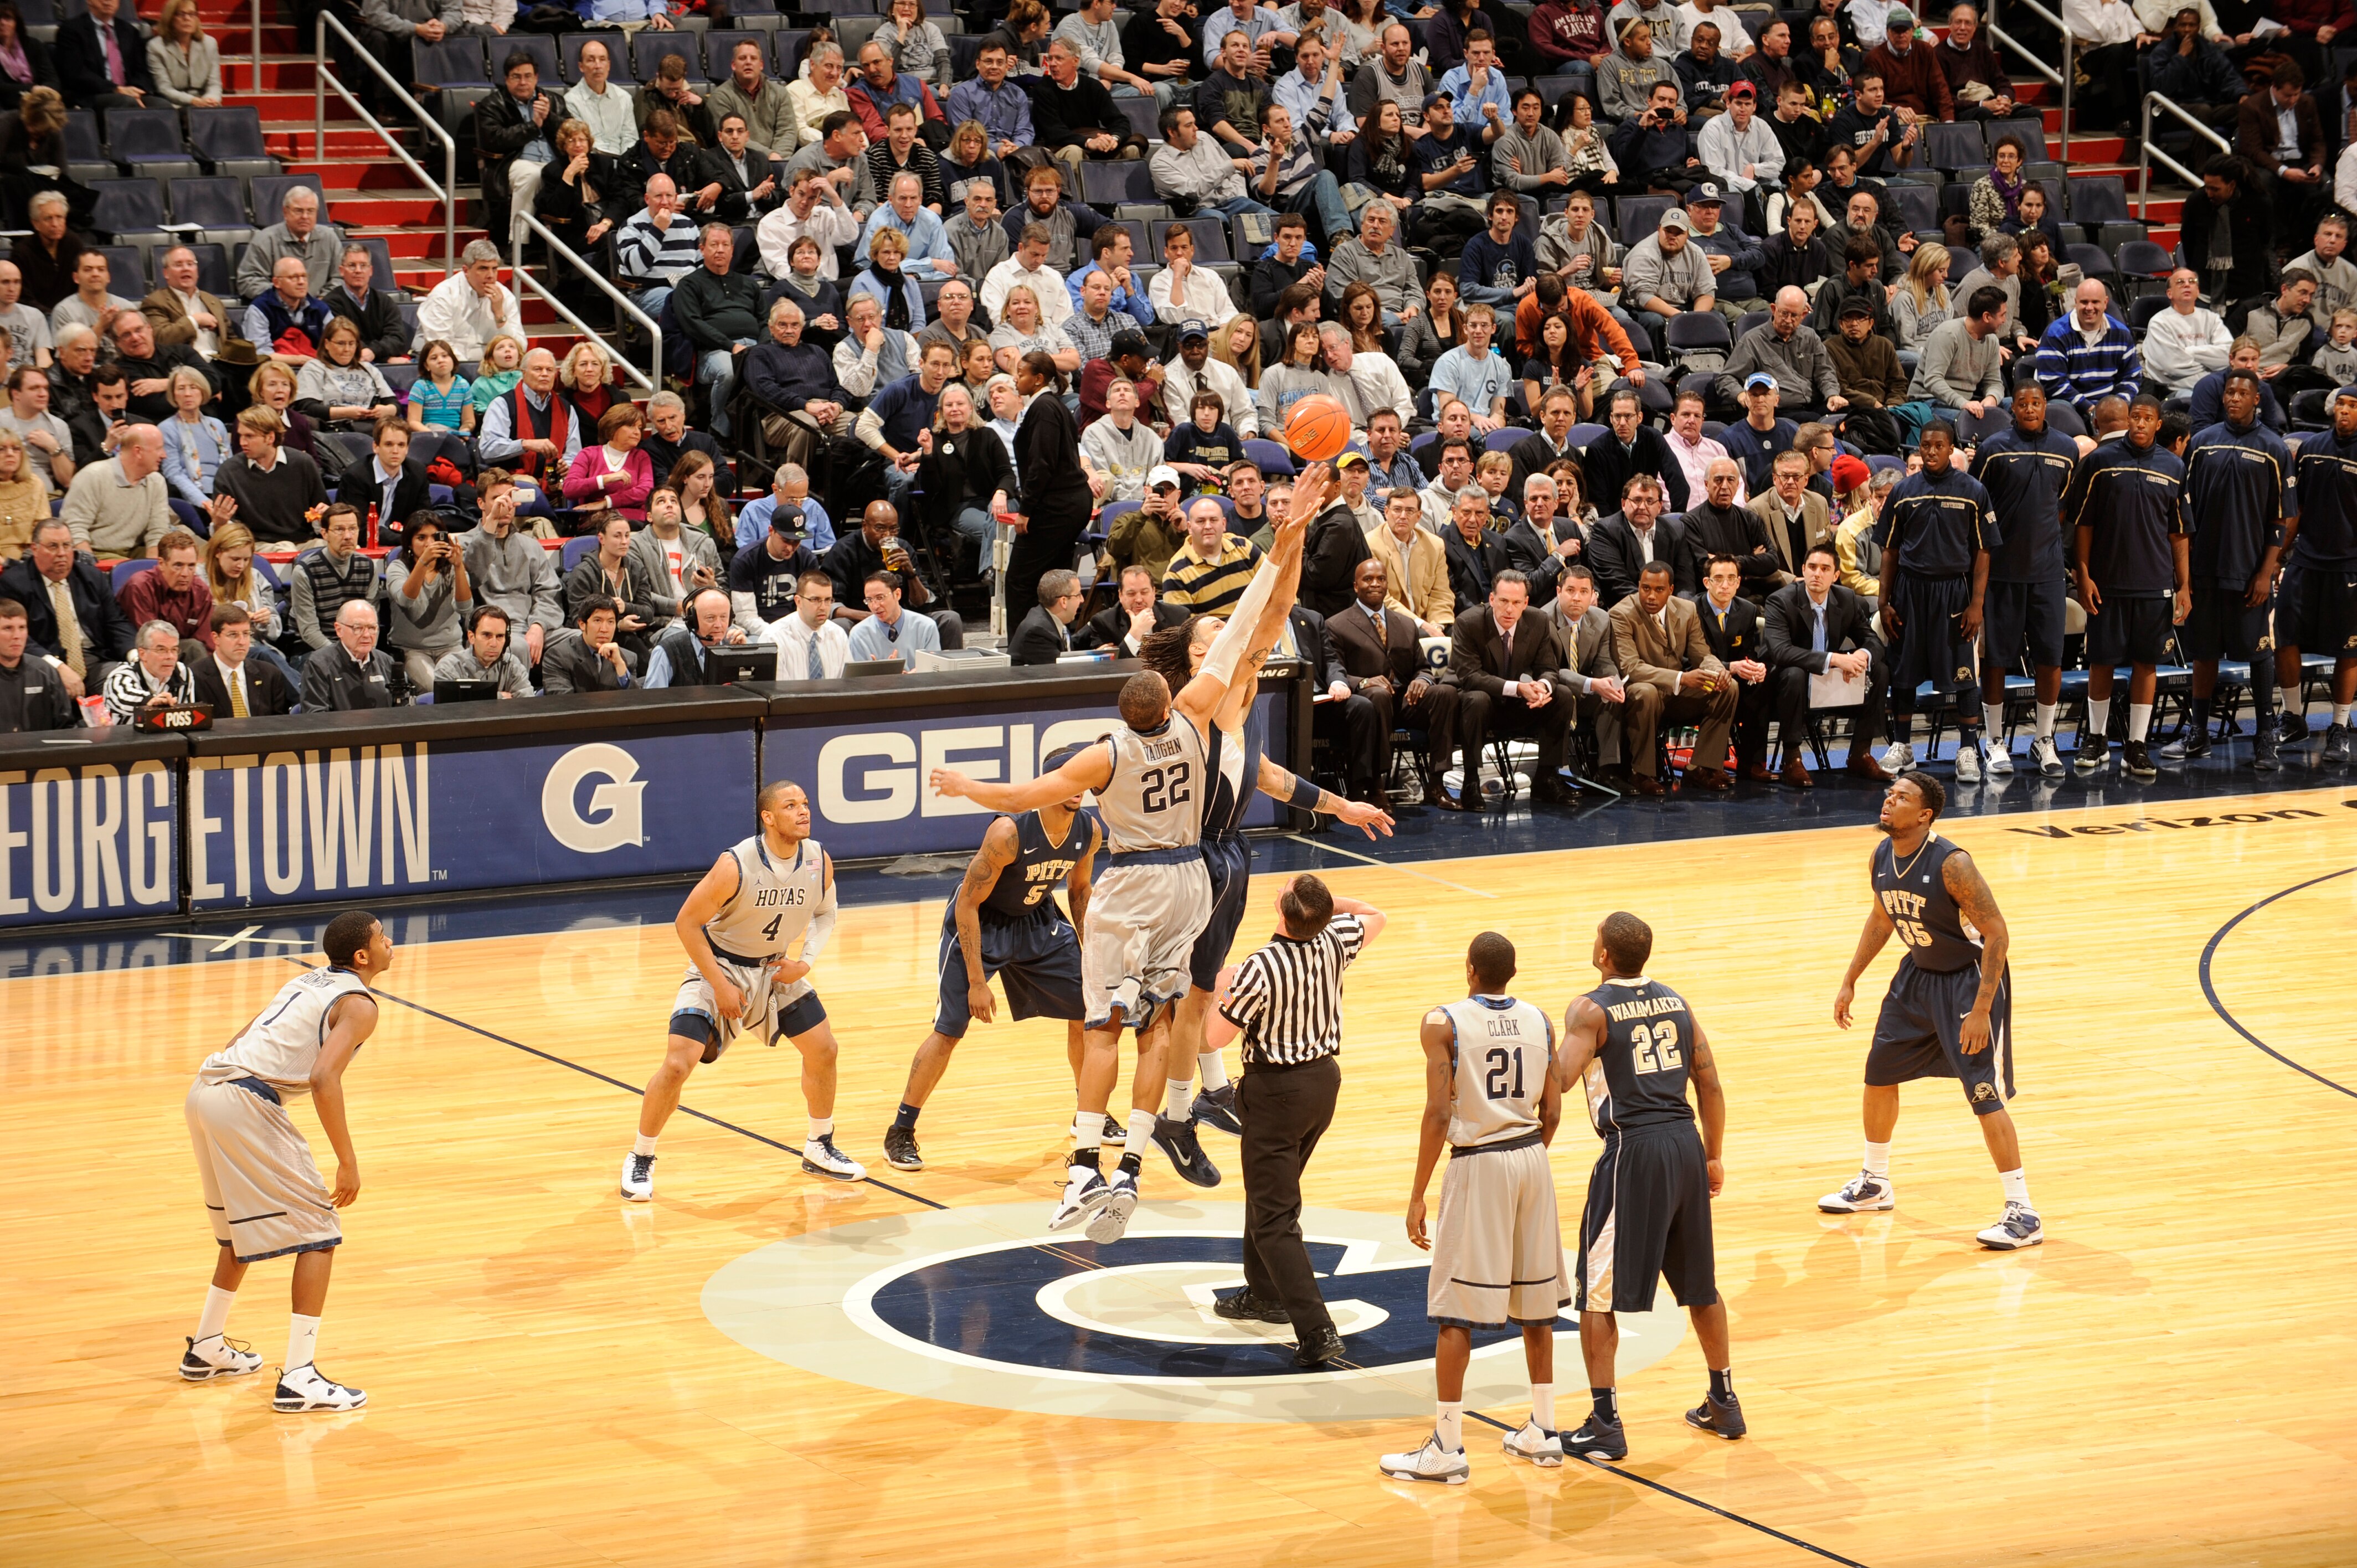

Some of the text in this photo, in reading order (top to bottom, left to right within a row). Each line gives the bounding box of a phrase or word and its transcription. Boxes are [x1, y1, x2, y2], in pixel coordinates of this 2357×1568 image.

[1554, 14, 1597, 29] AMERICAN
[1563, 20, 1595, 38] EAGLE
[1619, 68, 1656, 85] PITT
[1453, 146, 1467, 161] GO
[1020, 340, 1032, 349] WE
[1486, 380, 1496, 394] G
[1293, 429, 1319, 449] ELITE
[1427, 646, 1449, 668] G
[2317, 665, 2335, 674] HOYAS
[2168, 676, 2186, 684] HOYAS
[1946, 694, 1957, 703] HOY
[2016, 688, 2035, 697] HOYAS
[166, 710, 192, 727] POSS
[1314, 739, 1330, 748] OYAS
[1390, 733, 1411, 741] HOYAS
[1142, 738, 1182, 762] VAUGHN
[1139, 760, 1190, 814] 22
[542, 742, 649, 853] G
[2003, 808, 2328, 839] Verizon
[431, 869, 447, 881] TM
[1025, 859, 1076, 881] PITT
[753, 886, 806, 907] HOYAS
[1023, 884, 1048, 905] 5
[1881, 890, 1926, 919] PITT
[760, 912, 784, 942] 4
[1896, 919, 1932, 946] 35
[262, 991, 302, 1026] 1
[1607, 997, 1685, 1022] WANAMAKER
[1487, 1019, 1520, 1037] CLARK
[1631, 1020, 1682, 1075] 22
[1485, 1045, 1526, 1101] 21
